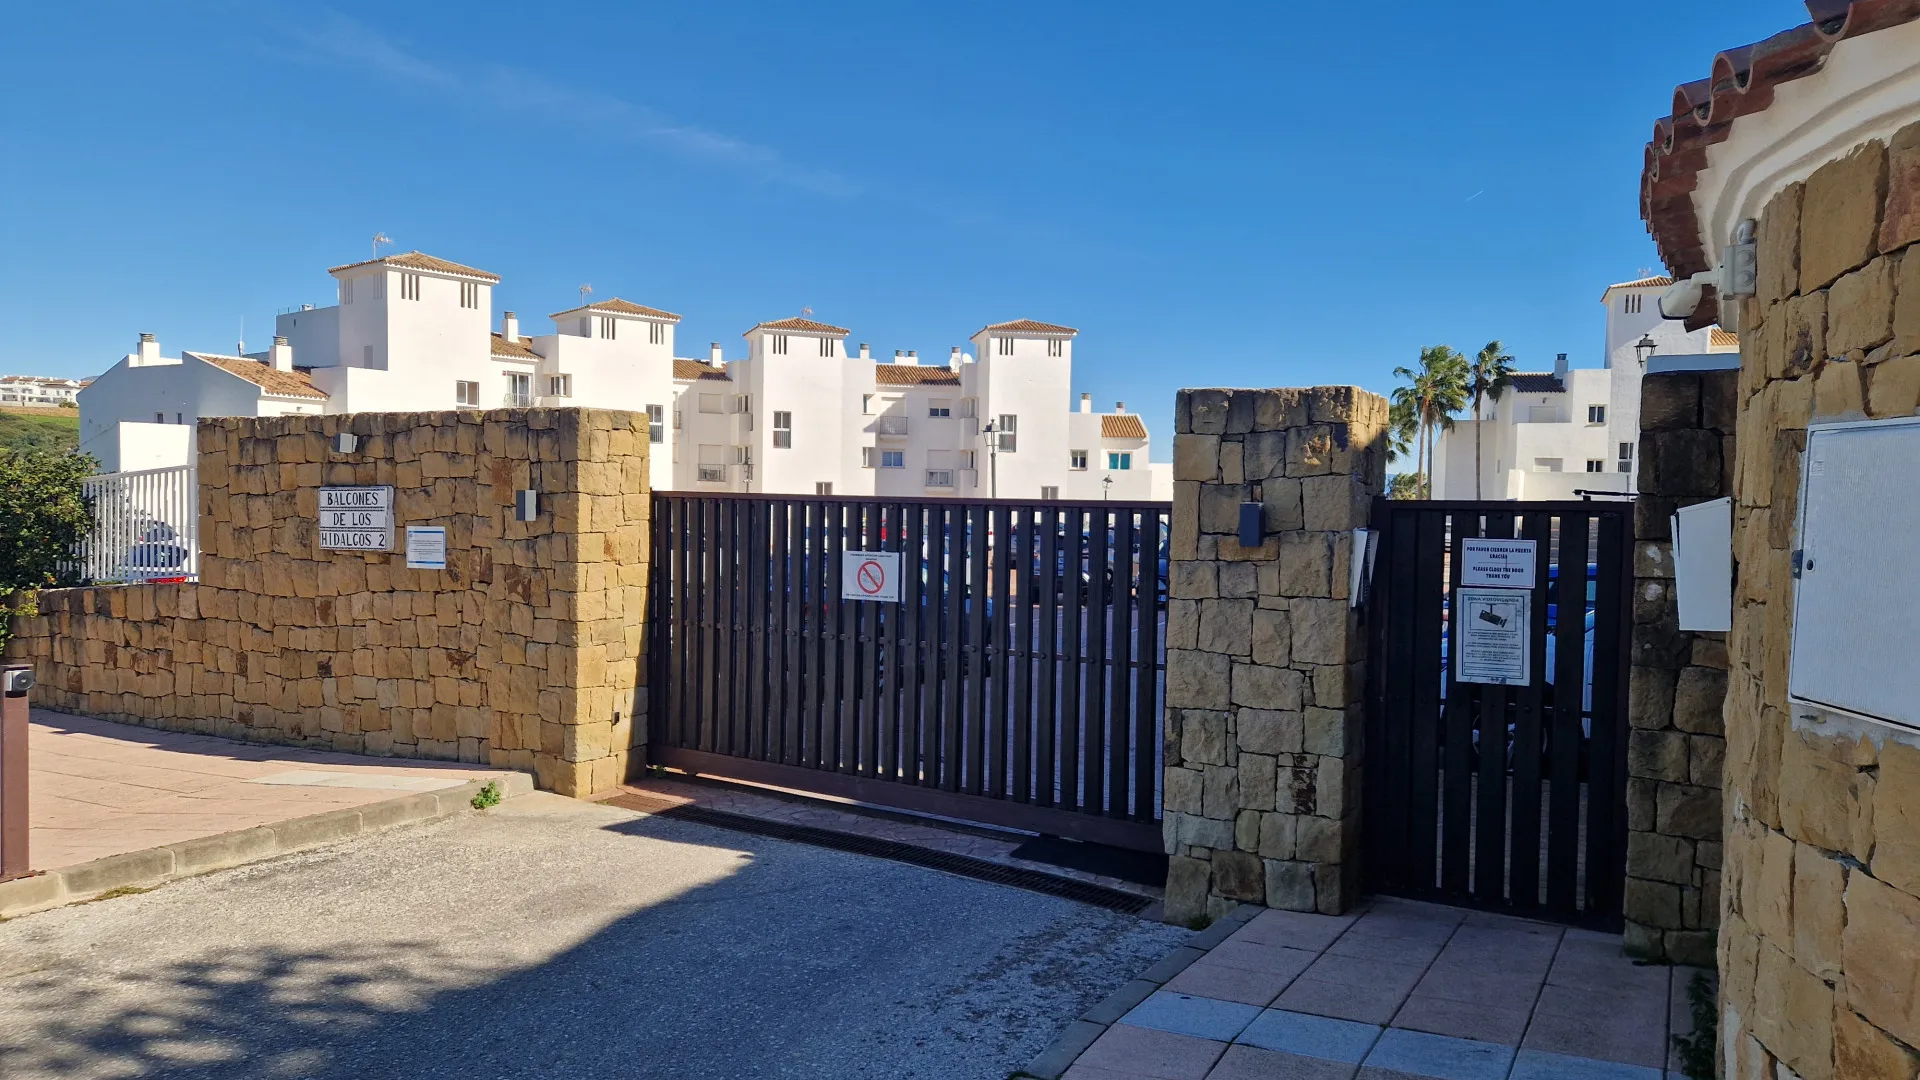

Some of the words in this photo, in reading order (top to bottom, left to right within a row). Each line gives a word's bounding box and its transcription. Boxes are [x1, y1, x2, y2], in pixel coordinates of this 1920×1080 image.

[327, 492, 378, 505] BALCONES
[333, 513, 345, 525] DE
[352, 513, 371, 525] LOS
[321, 532, 371, 546] HIDALGOS
[378, 533, 385, 547] 2
